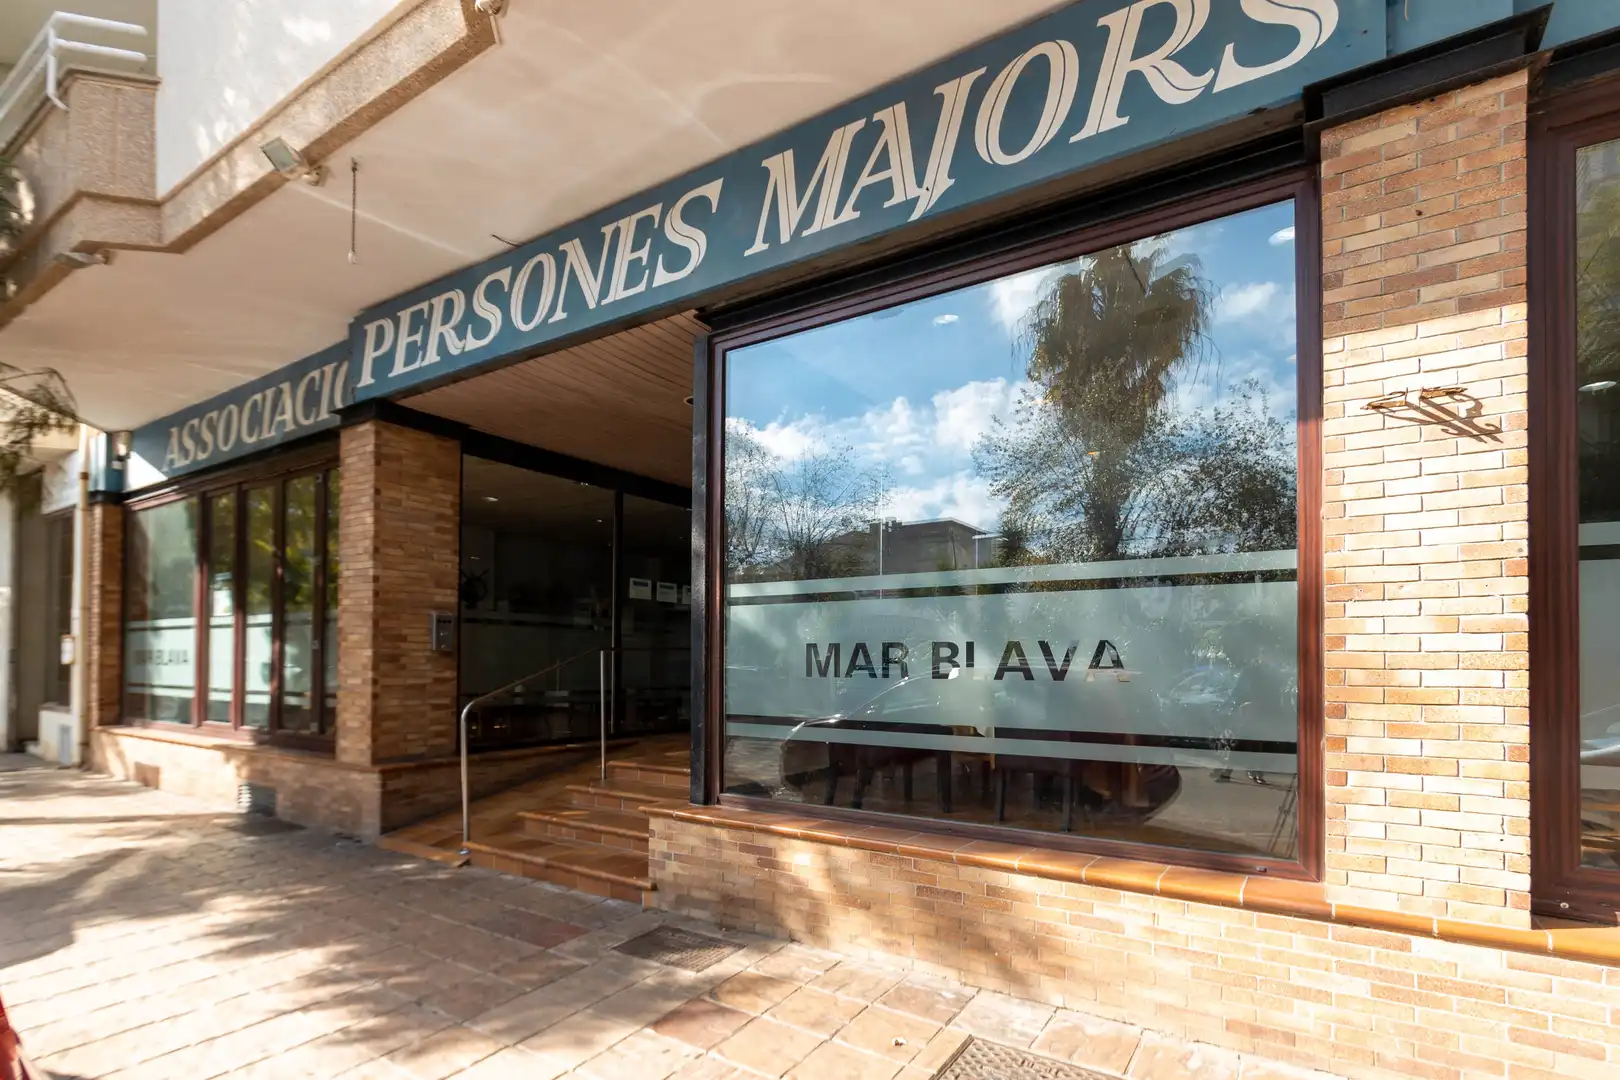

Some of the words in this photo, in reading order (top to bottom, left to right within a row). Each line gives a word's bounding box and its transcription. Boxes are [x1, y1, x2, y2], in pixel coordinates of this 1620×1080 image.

[357, 177, 724, 388] PERSONES
[743, 0, 1338, 256] MAJORS
[805, 641, 909, 680] MAR
